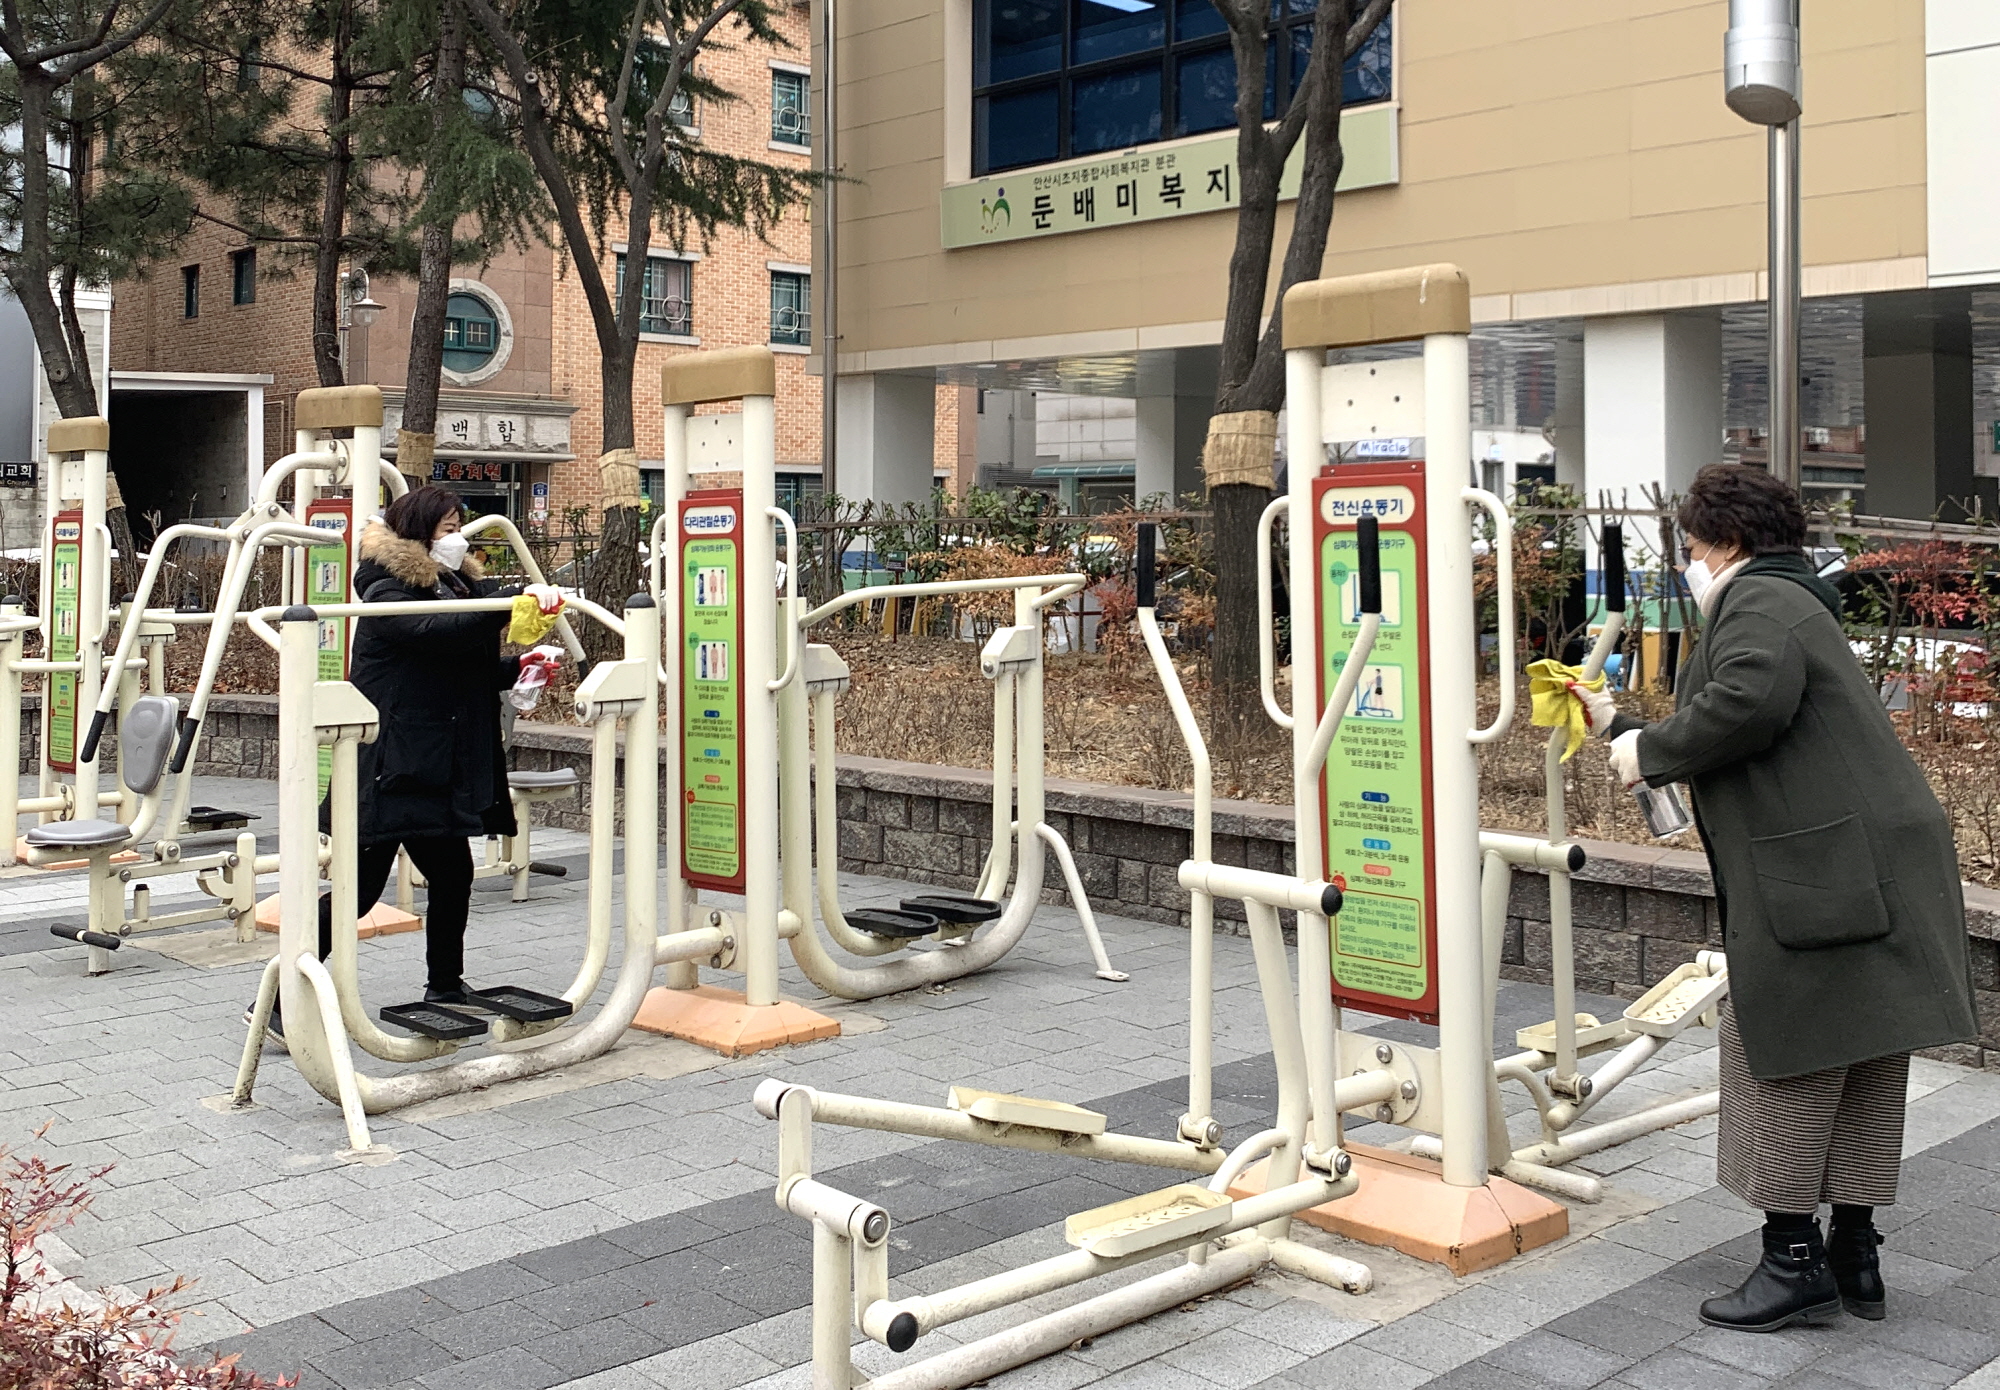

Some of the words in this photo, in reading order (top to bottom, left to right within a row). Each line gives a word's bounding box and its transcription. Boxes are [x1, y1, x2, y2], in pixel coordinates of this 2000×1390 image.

[1031, 164, 1280, 229] 둔배미복지
[452, 419, 515, 442] 백합
[1332, 499, 1403, 516] 전신운동기
[684, 515, 735, 528] 다리관절운동기
